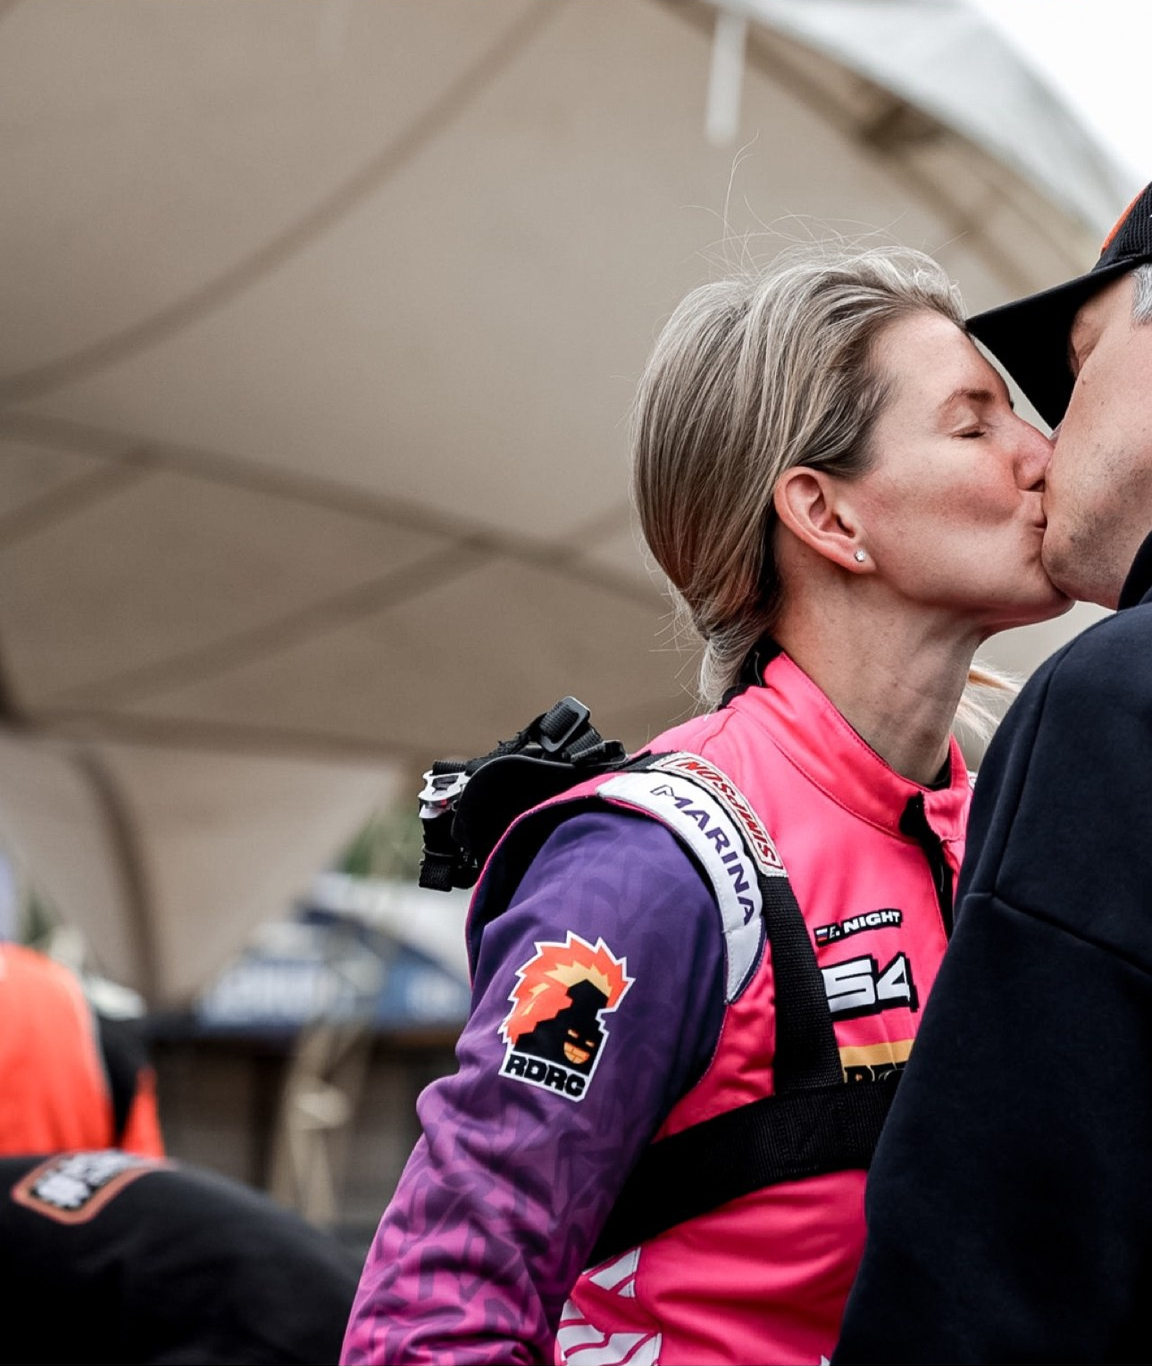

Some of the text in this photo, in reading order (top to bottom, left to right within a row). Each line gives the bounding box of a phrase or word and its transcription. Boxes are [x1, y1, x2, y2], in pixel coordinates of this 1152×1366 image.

[675, 760, 777, 863] SIMPSON
[650, 784, 756, 926] MARINA
[843, 911, 901, 934] NIGHT
[821, 955, 911, 1013] 54
